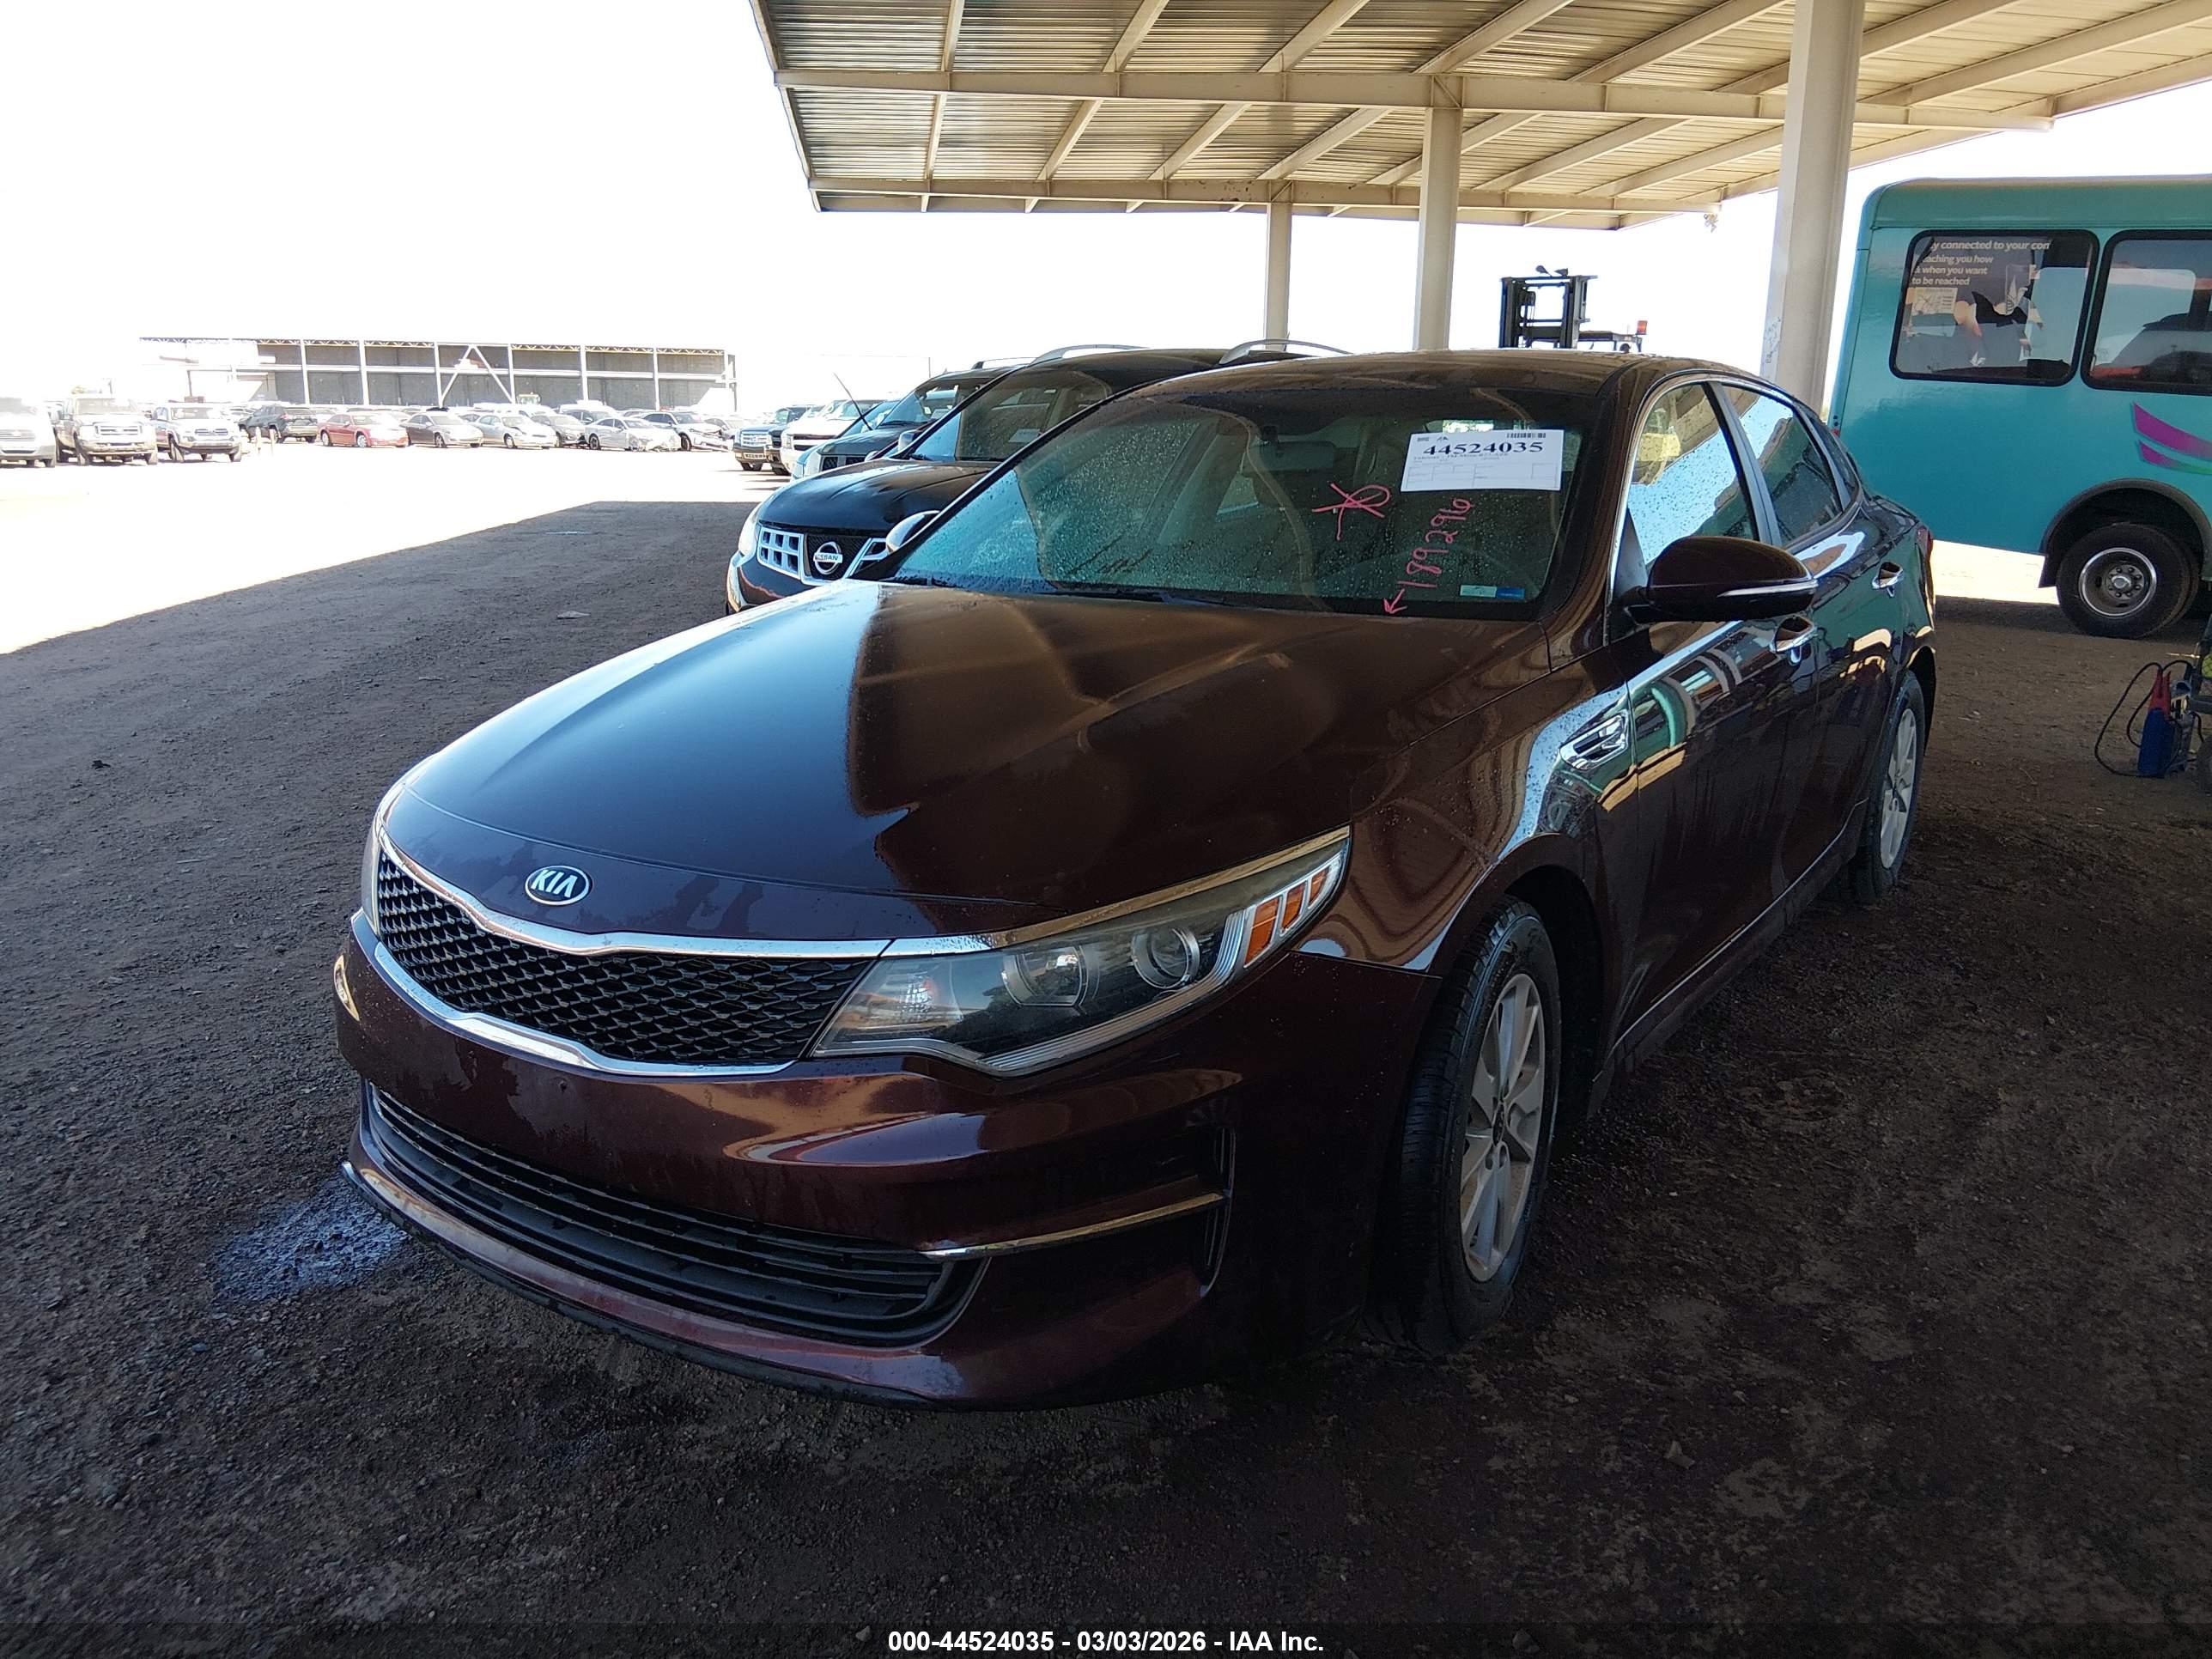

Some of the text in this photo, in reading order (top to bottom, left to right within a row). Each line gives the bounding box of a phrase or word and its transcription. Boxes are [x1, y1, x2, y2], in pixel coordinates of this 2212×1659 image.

[1941, 240, 1992, 250] connected
[2004, 241, 2030, 252] your
[1954, 256, 1973, 265] you
[1974, 254, 1994, 264] how
[1923, 265, 1947, 274] when
[1947, 267, 1964, 276] you
[1965, 266, 1988, 275] want
[1911, 276, 1971, 285] to be reached
[1423, 441, 1543, 455] 44524035
[531, 869, 578, 898] KIA
